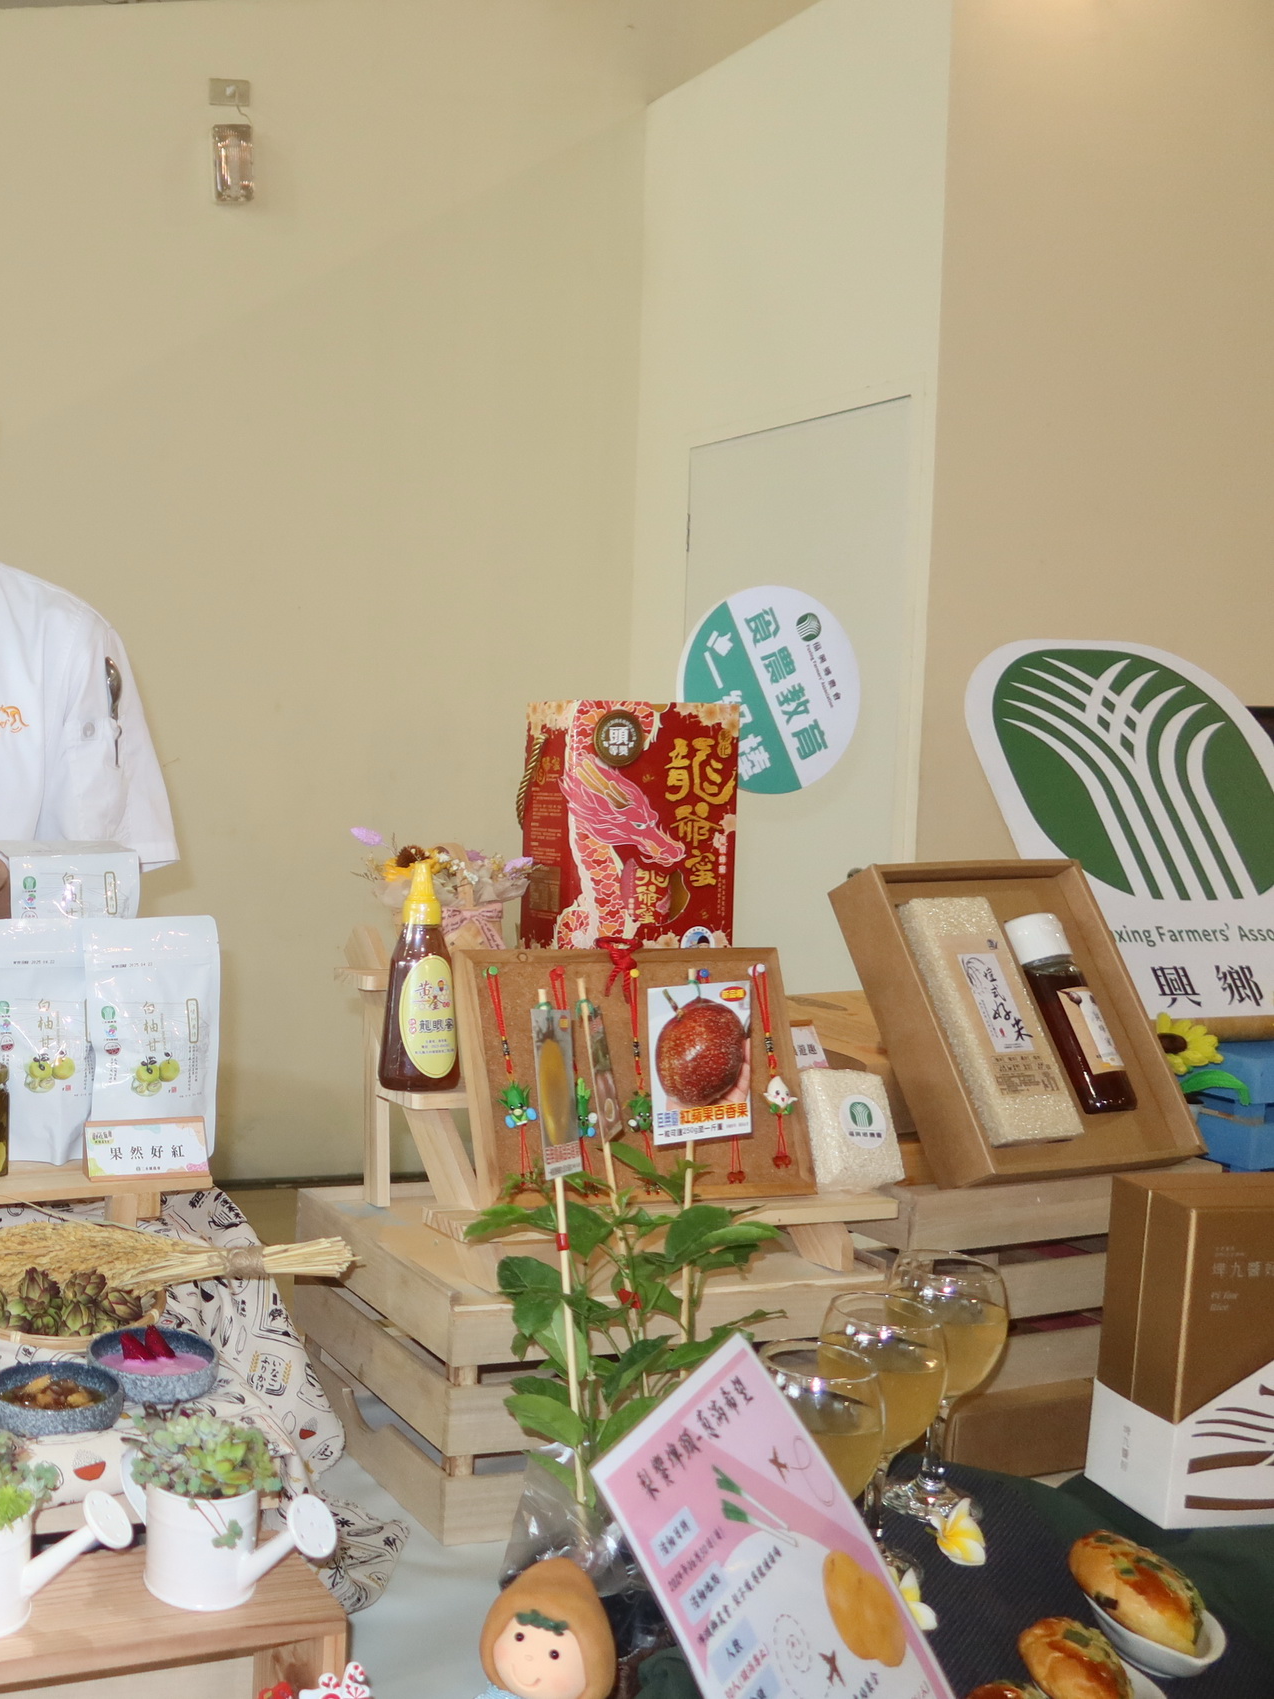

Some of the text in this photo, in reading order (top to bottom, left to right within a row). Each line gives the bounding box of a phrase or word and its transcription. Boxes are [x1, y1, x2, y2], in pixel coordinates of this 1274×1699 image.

[744, 606, 829, 761] 食農教育
[609, 726, 629, 744] 頭
[1113, 925, 1157, 947] xing
[1155, 923, 1230, 942] Farmers'
[679, 1102, 749, 1124] 紅蘋果百香果
[110, 1144, 186, 1161] 果然好紅
